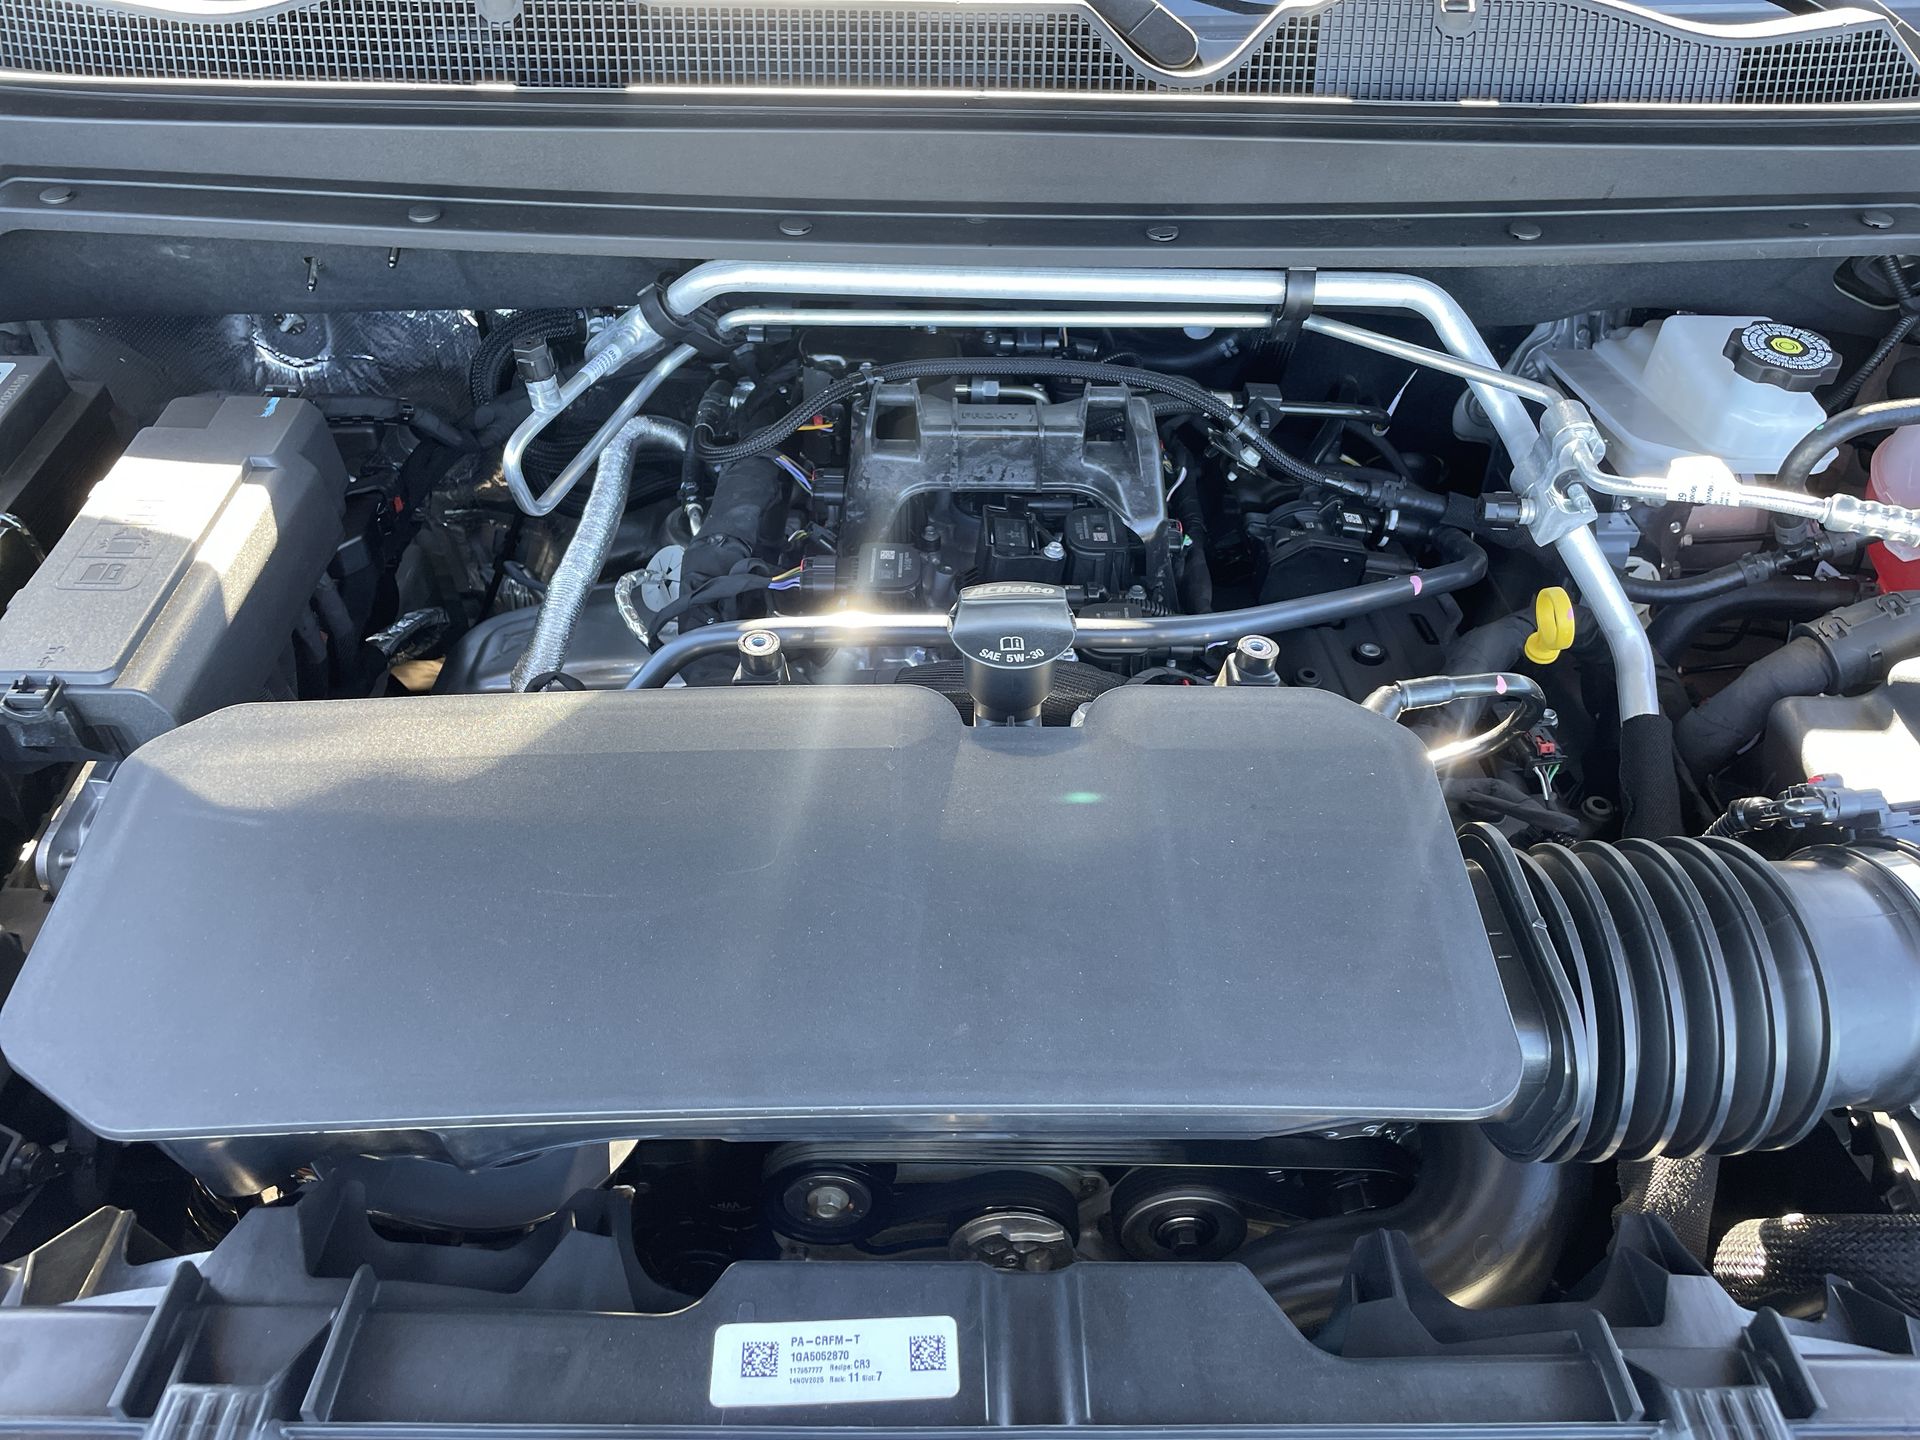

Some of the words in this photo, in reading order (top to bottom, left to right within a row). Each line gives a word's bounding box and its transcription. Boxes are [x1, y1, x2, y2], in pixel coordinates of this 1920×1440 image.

[969, 585, 1055, 596] ACDelco
[978, 648, 1001, 662] SAE
[1006, 648, 1045, 663] 5W-30
[853, 1359, 871, 1369] CR3
[848, 1372, 859, 1383] 11
